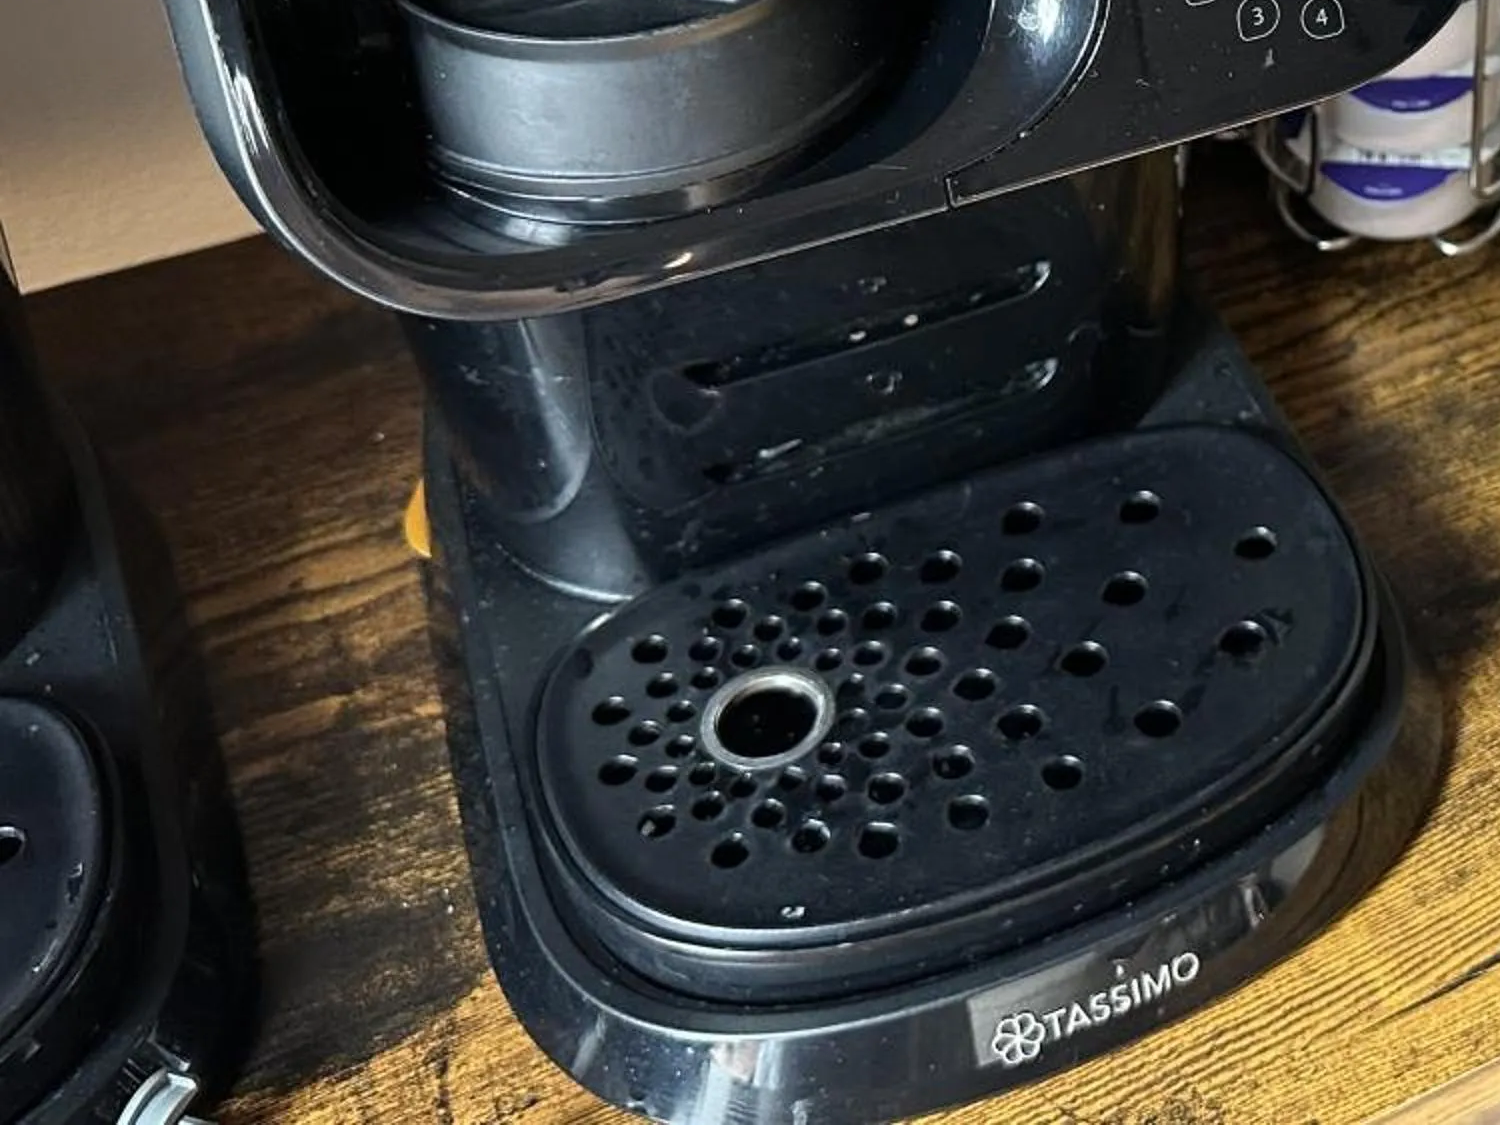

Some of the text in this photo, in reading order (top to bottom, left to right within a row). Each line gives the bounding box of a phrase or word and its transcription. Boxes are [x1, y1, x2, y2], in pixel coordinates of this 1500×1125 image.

[1251, 7, 1265, 26] 3
[1315, 8, 1329, 25] 4
[1043, 952, 1200, 1040] TASSIMO
